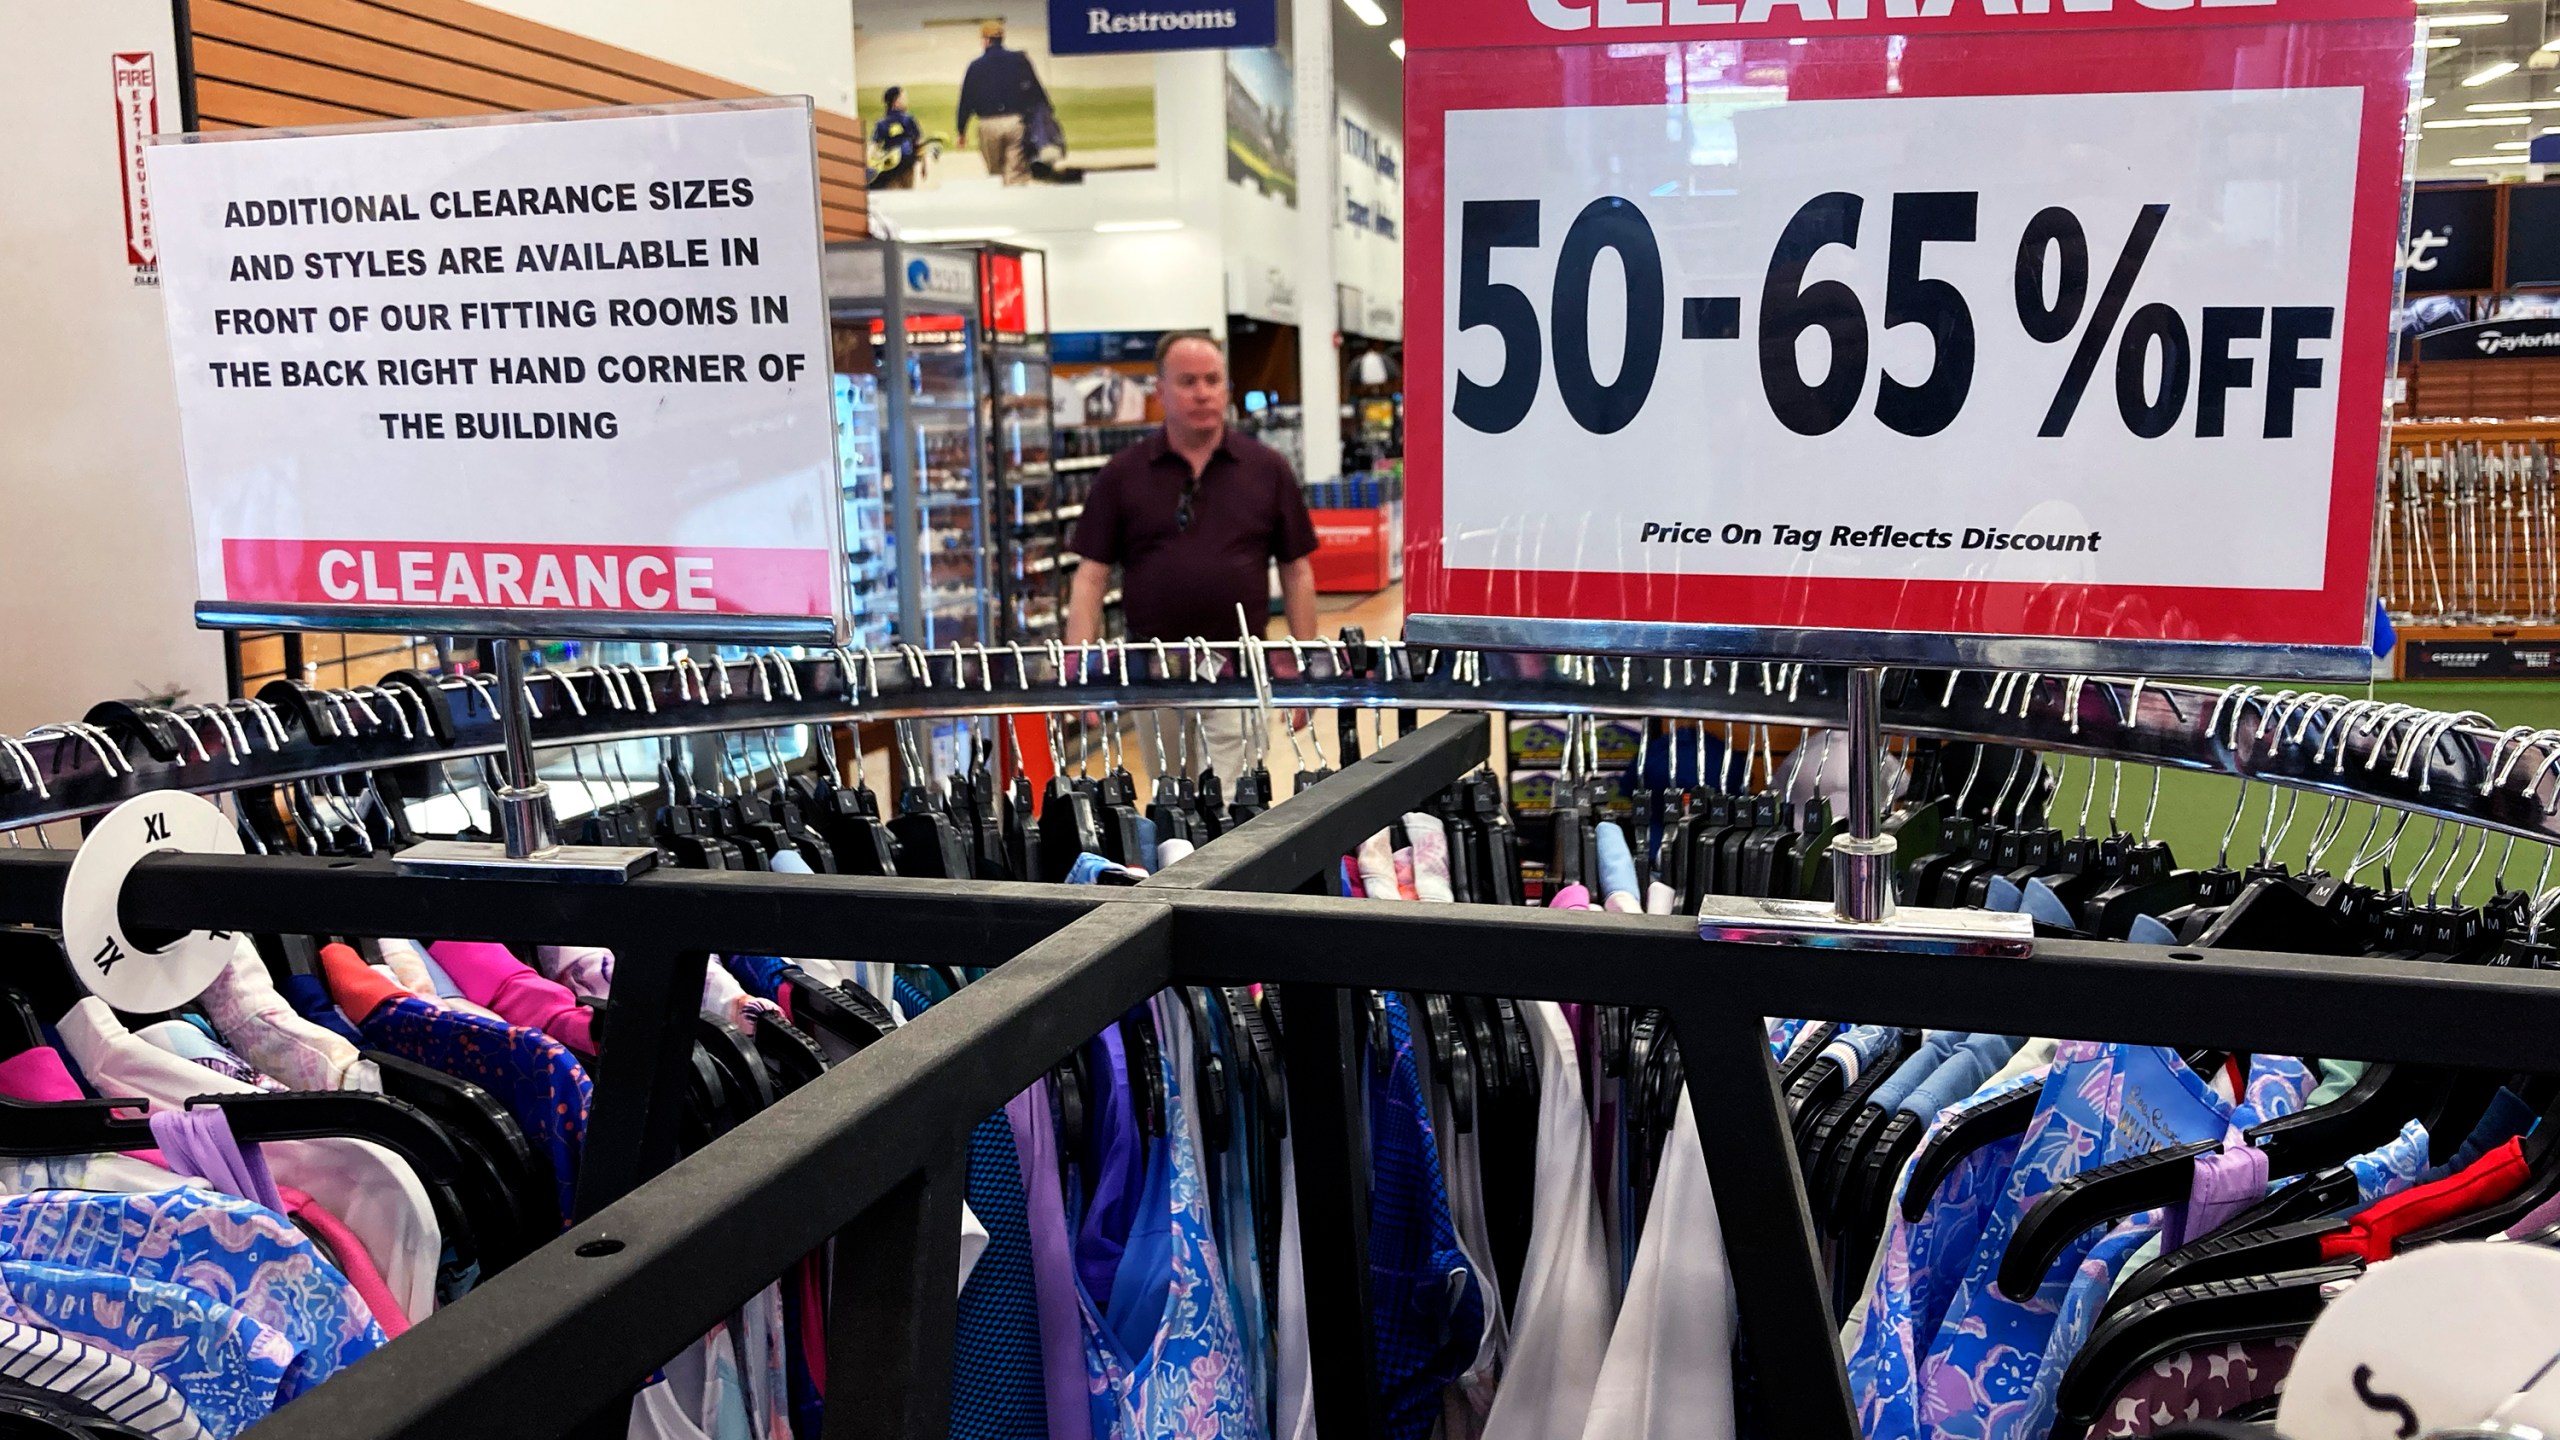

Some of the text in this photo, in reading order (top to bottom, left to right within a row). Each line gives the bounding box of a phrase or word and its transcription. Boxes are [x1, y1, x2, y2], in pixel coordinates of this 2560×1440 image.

[1086, 8, 1237, 34] Restrooms
[118, 69, 151, 87] FIRE
[225, 178, 755, 228] ADDITIONAL CLEARANCE SIZES
[230, 238, 759, 281] AND STYLES ARE AVAILABLE IN
[214, 296, 789, 335] FRONT OF OUR FITTING ROOMS IN
[209, 354, 806, 388] THE BACK RIGHT HAND CORNER OF
[379, 412, 618, 440] THE BUILDING
[1641, 522, 2102, 552] Price On Tag Reflects Discount
[318, 548, 717, 611] CLEARANCE
[1166, 787, 1172, 795] L
[1595, 786, 1607, 794] XL
[1022, 796, 1028, 804] L
[746, 807, 753, 815] L
[928, 802, 936, 811] L
[1665, 804, 1678, 813] XL
[1712, 807, 1725, 815] XL
[1759, 806, 1772, 815] XL
[725, 818, 732, 827] L
[791, 815, 797, 823] L
[1809, 812, 1817, 822] M
[143, 812, 171, 843] XL
[699, 818, 706, 828] L
[1945, 830, 1954, 839] M
[1979, 838, 1988, 850] M
[2005, 847, 2013, 857] M
[2034, 845, 2042, 855] M
[2068, 853, 2077, 862] M
[2107, 856, 2116, 866] M
[2131, 864, 2139, 875] M
[2200, 884, 2212, 896] M
[2316, 886, 2330, 896] M
[2340, 895, 2353, 915] M
[2413, 924, 2422, 935] M
[2466, 920, 2475, 938] M
[2488, 918, 2499, 930] M
[2385, 928, 2394, 939] M
[2438, 928, 2450, 940] M
[93, 935, 125, 976] XL
[2497, 954, 2511, 966] M
